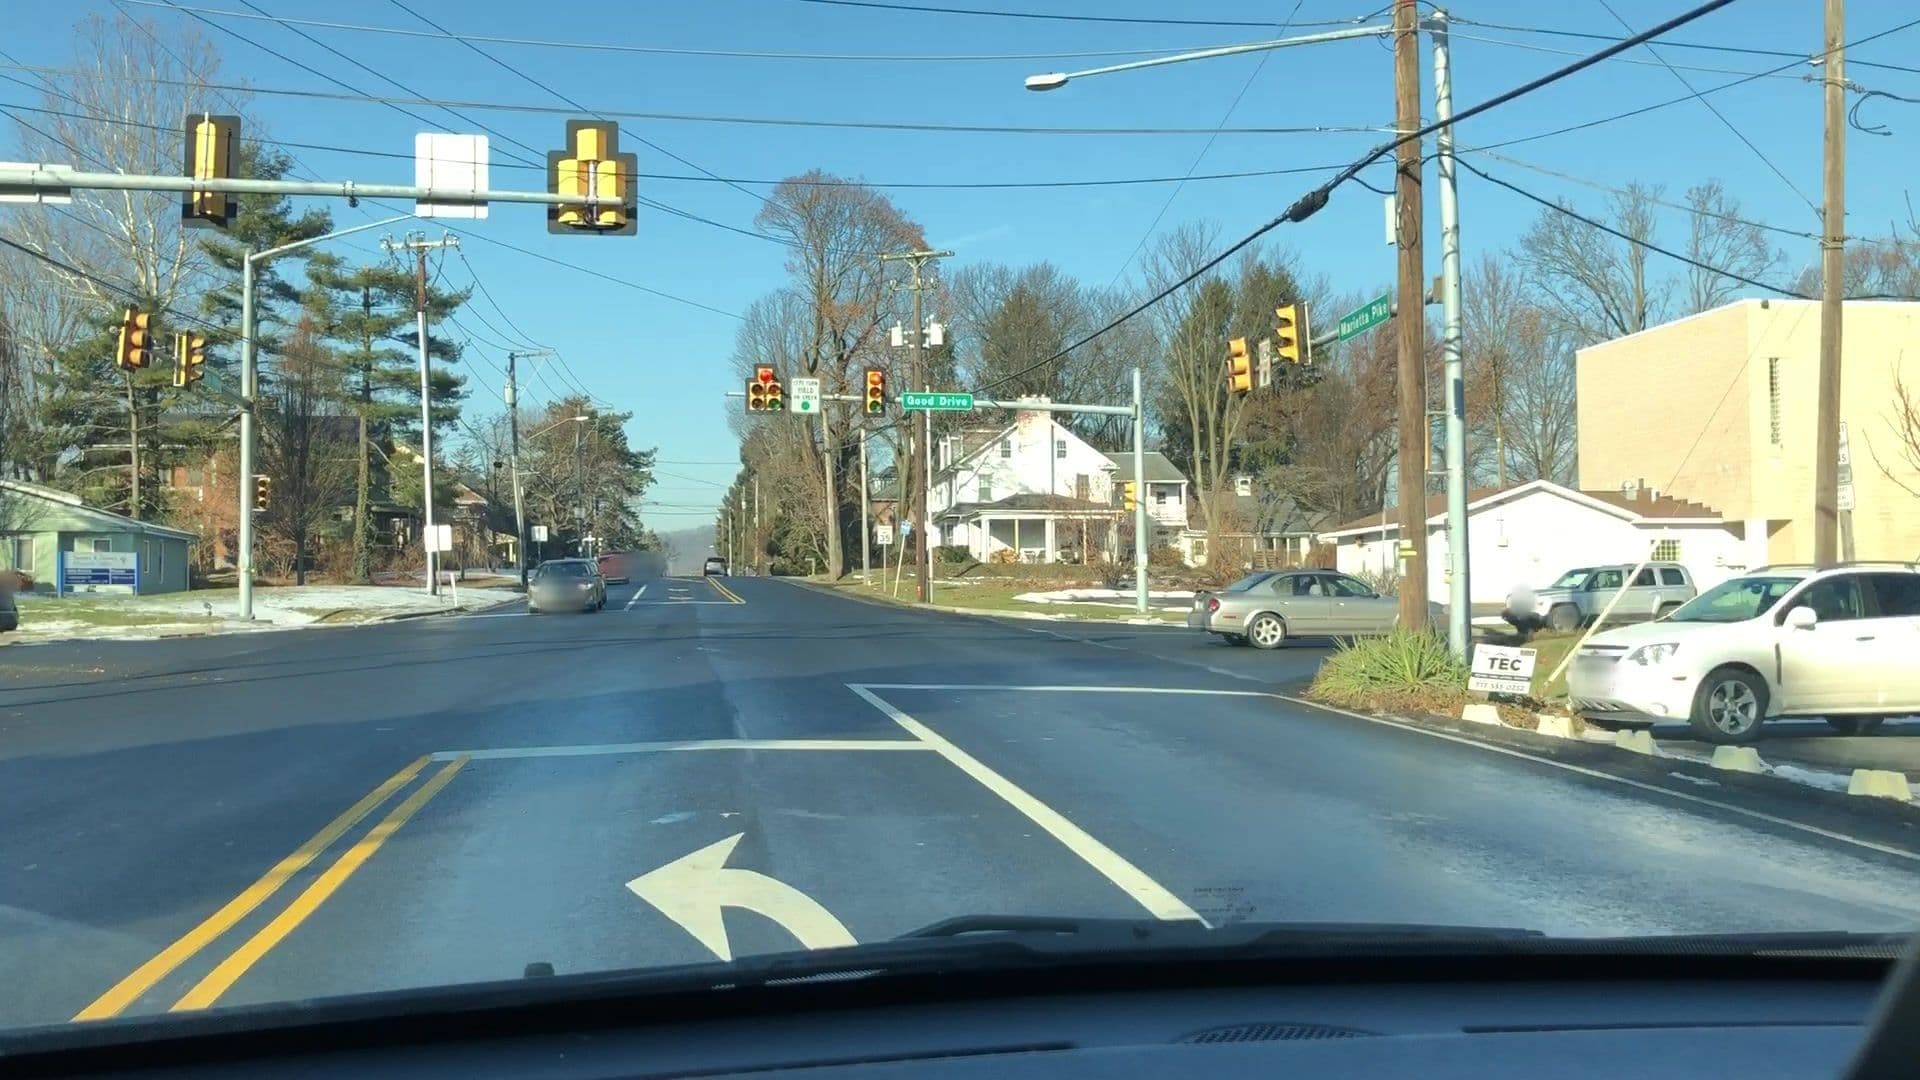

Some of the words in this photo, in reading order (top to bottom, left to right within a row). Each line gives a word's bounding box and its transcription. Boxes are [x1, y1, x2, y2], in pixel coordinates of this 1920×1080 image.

[1341, 312, 1370, 336] Marietta
[1371, 302, 1387, 320] Pike
[906, 395, 935, 406] Good
[939, 395, 969, 407] Drive
[1488, 657, 1522, 671] TEC
